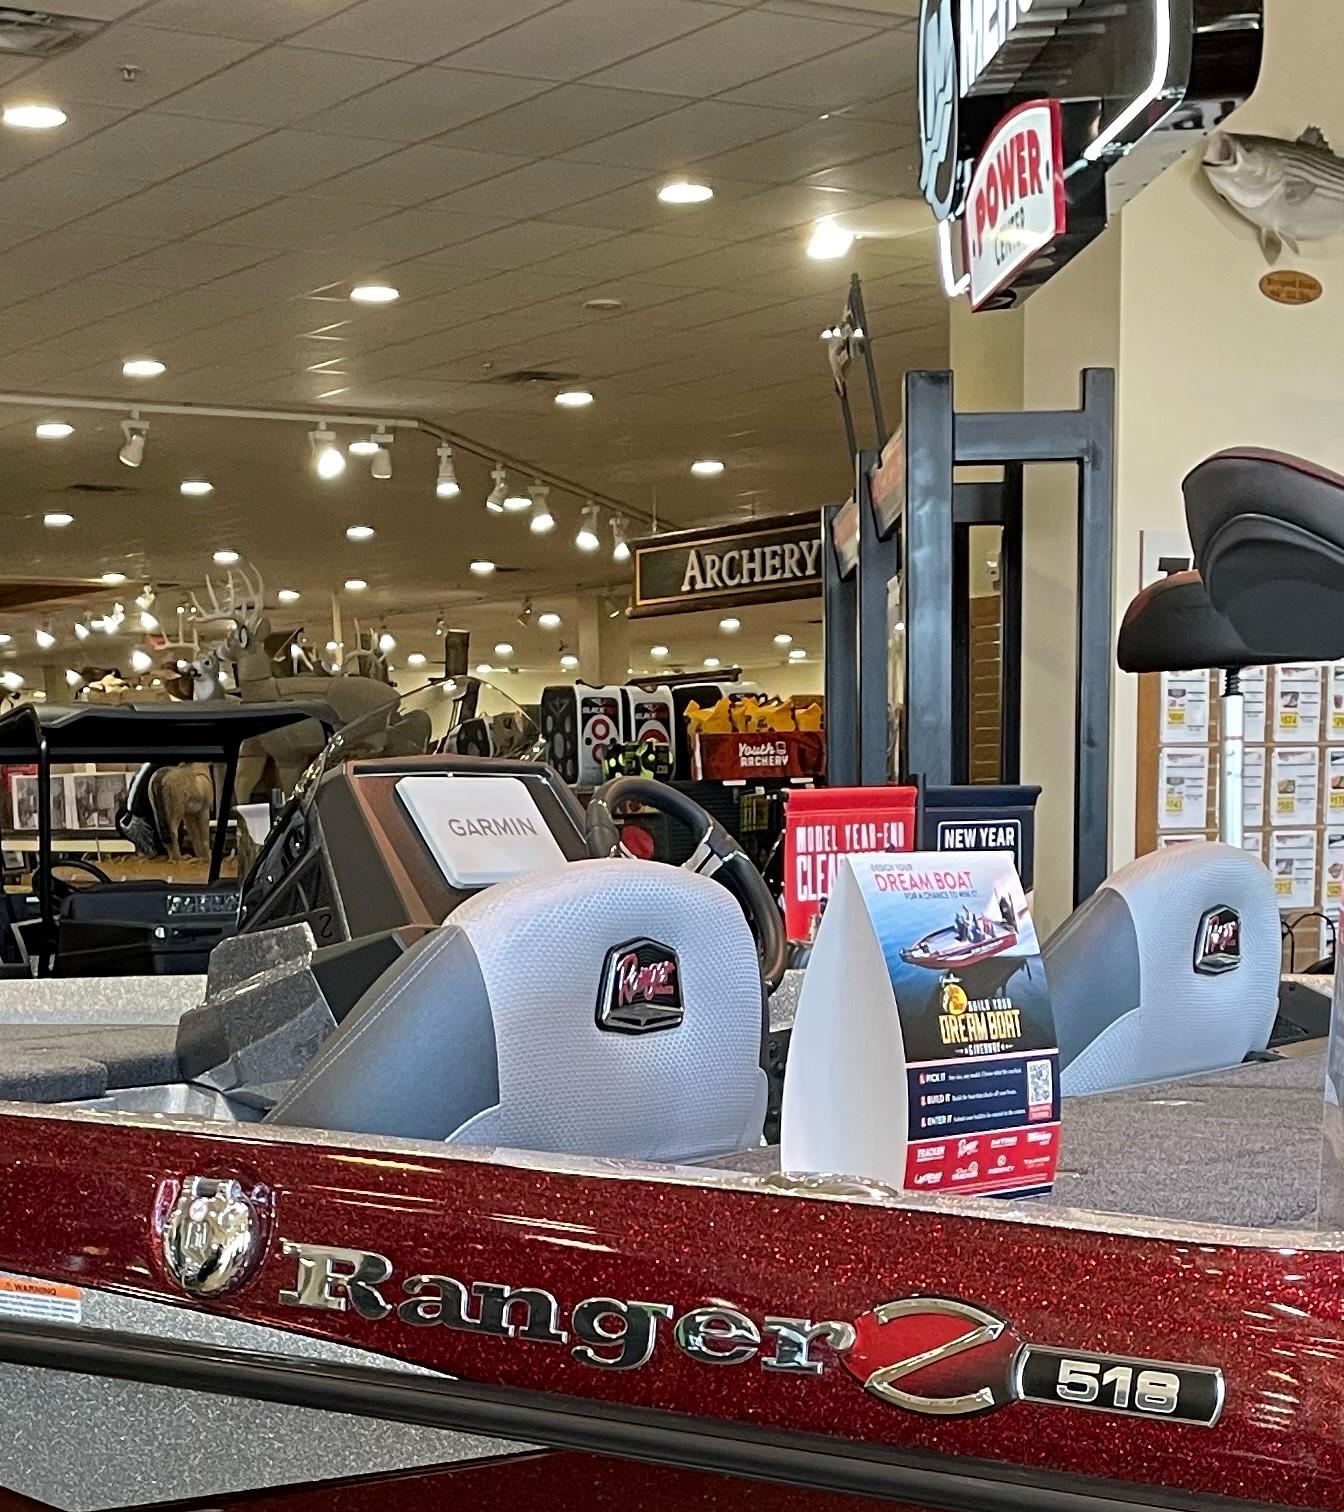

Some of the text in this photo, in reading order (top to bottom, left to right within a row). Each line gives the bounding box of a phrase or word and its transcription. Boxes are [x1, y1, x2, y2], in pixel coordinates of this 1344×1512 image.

[975, 129, 1043, 257] POWER
[681, 540, 822, 592] ARCHERY
[738, 742, 776, 756] Youth
[740, 755, 788, 767] ARCHERY
[448, 818, 538, 837] GARMIN
[796, 822, 905, 853] MODEL YEAR-END
[944, 827, 1015, 848] NEW YEAR
[874, 871, 975, 892] DREAM BOAT
[939, 1010, 1022, 1044] DREAM BOAT
[15, 1283, 57, 1296] WARNING
[278, 1237, 857, 1374] Ranger
[1056, 1360, 1181, 1415] 518
